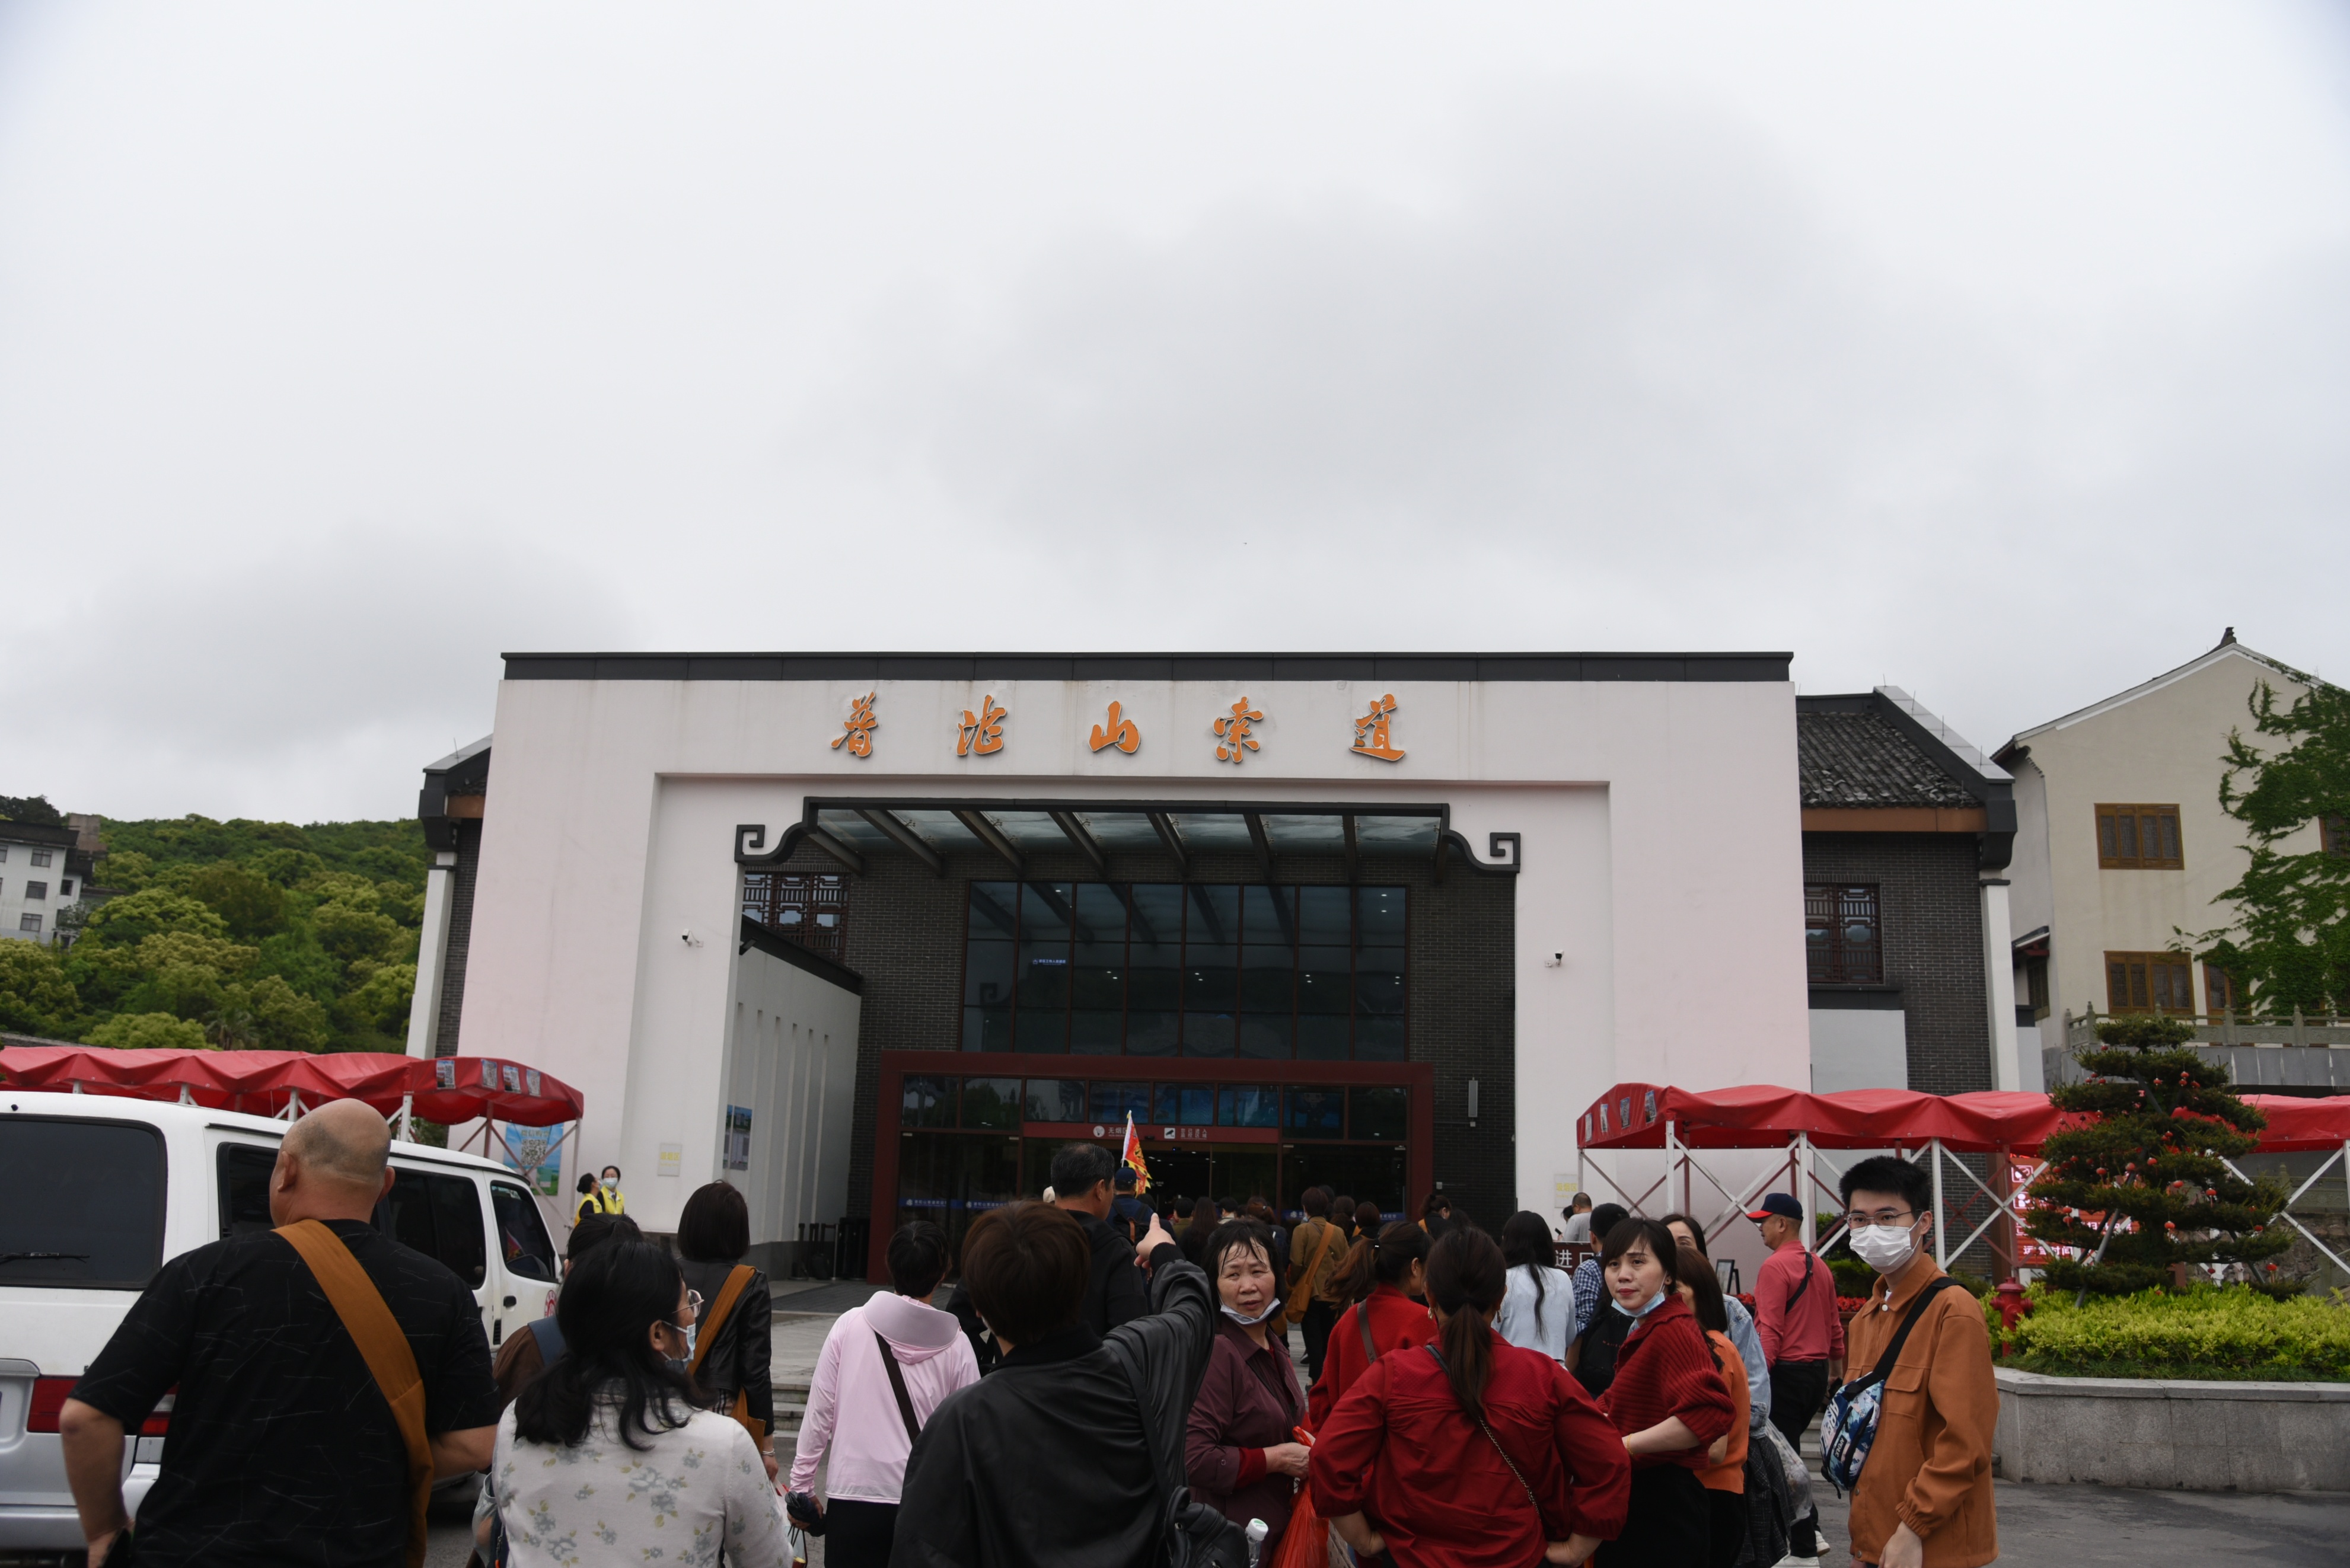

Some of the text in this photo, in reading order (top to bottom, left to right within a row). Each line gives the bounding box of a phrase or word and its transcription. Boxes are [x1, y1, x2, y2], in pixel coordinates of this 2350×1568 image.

[831, 691, 1407, 764] 普陀山索道
